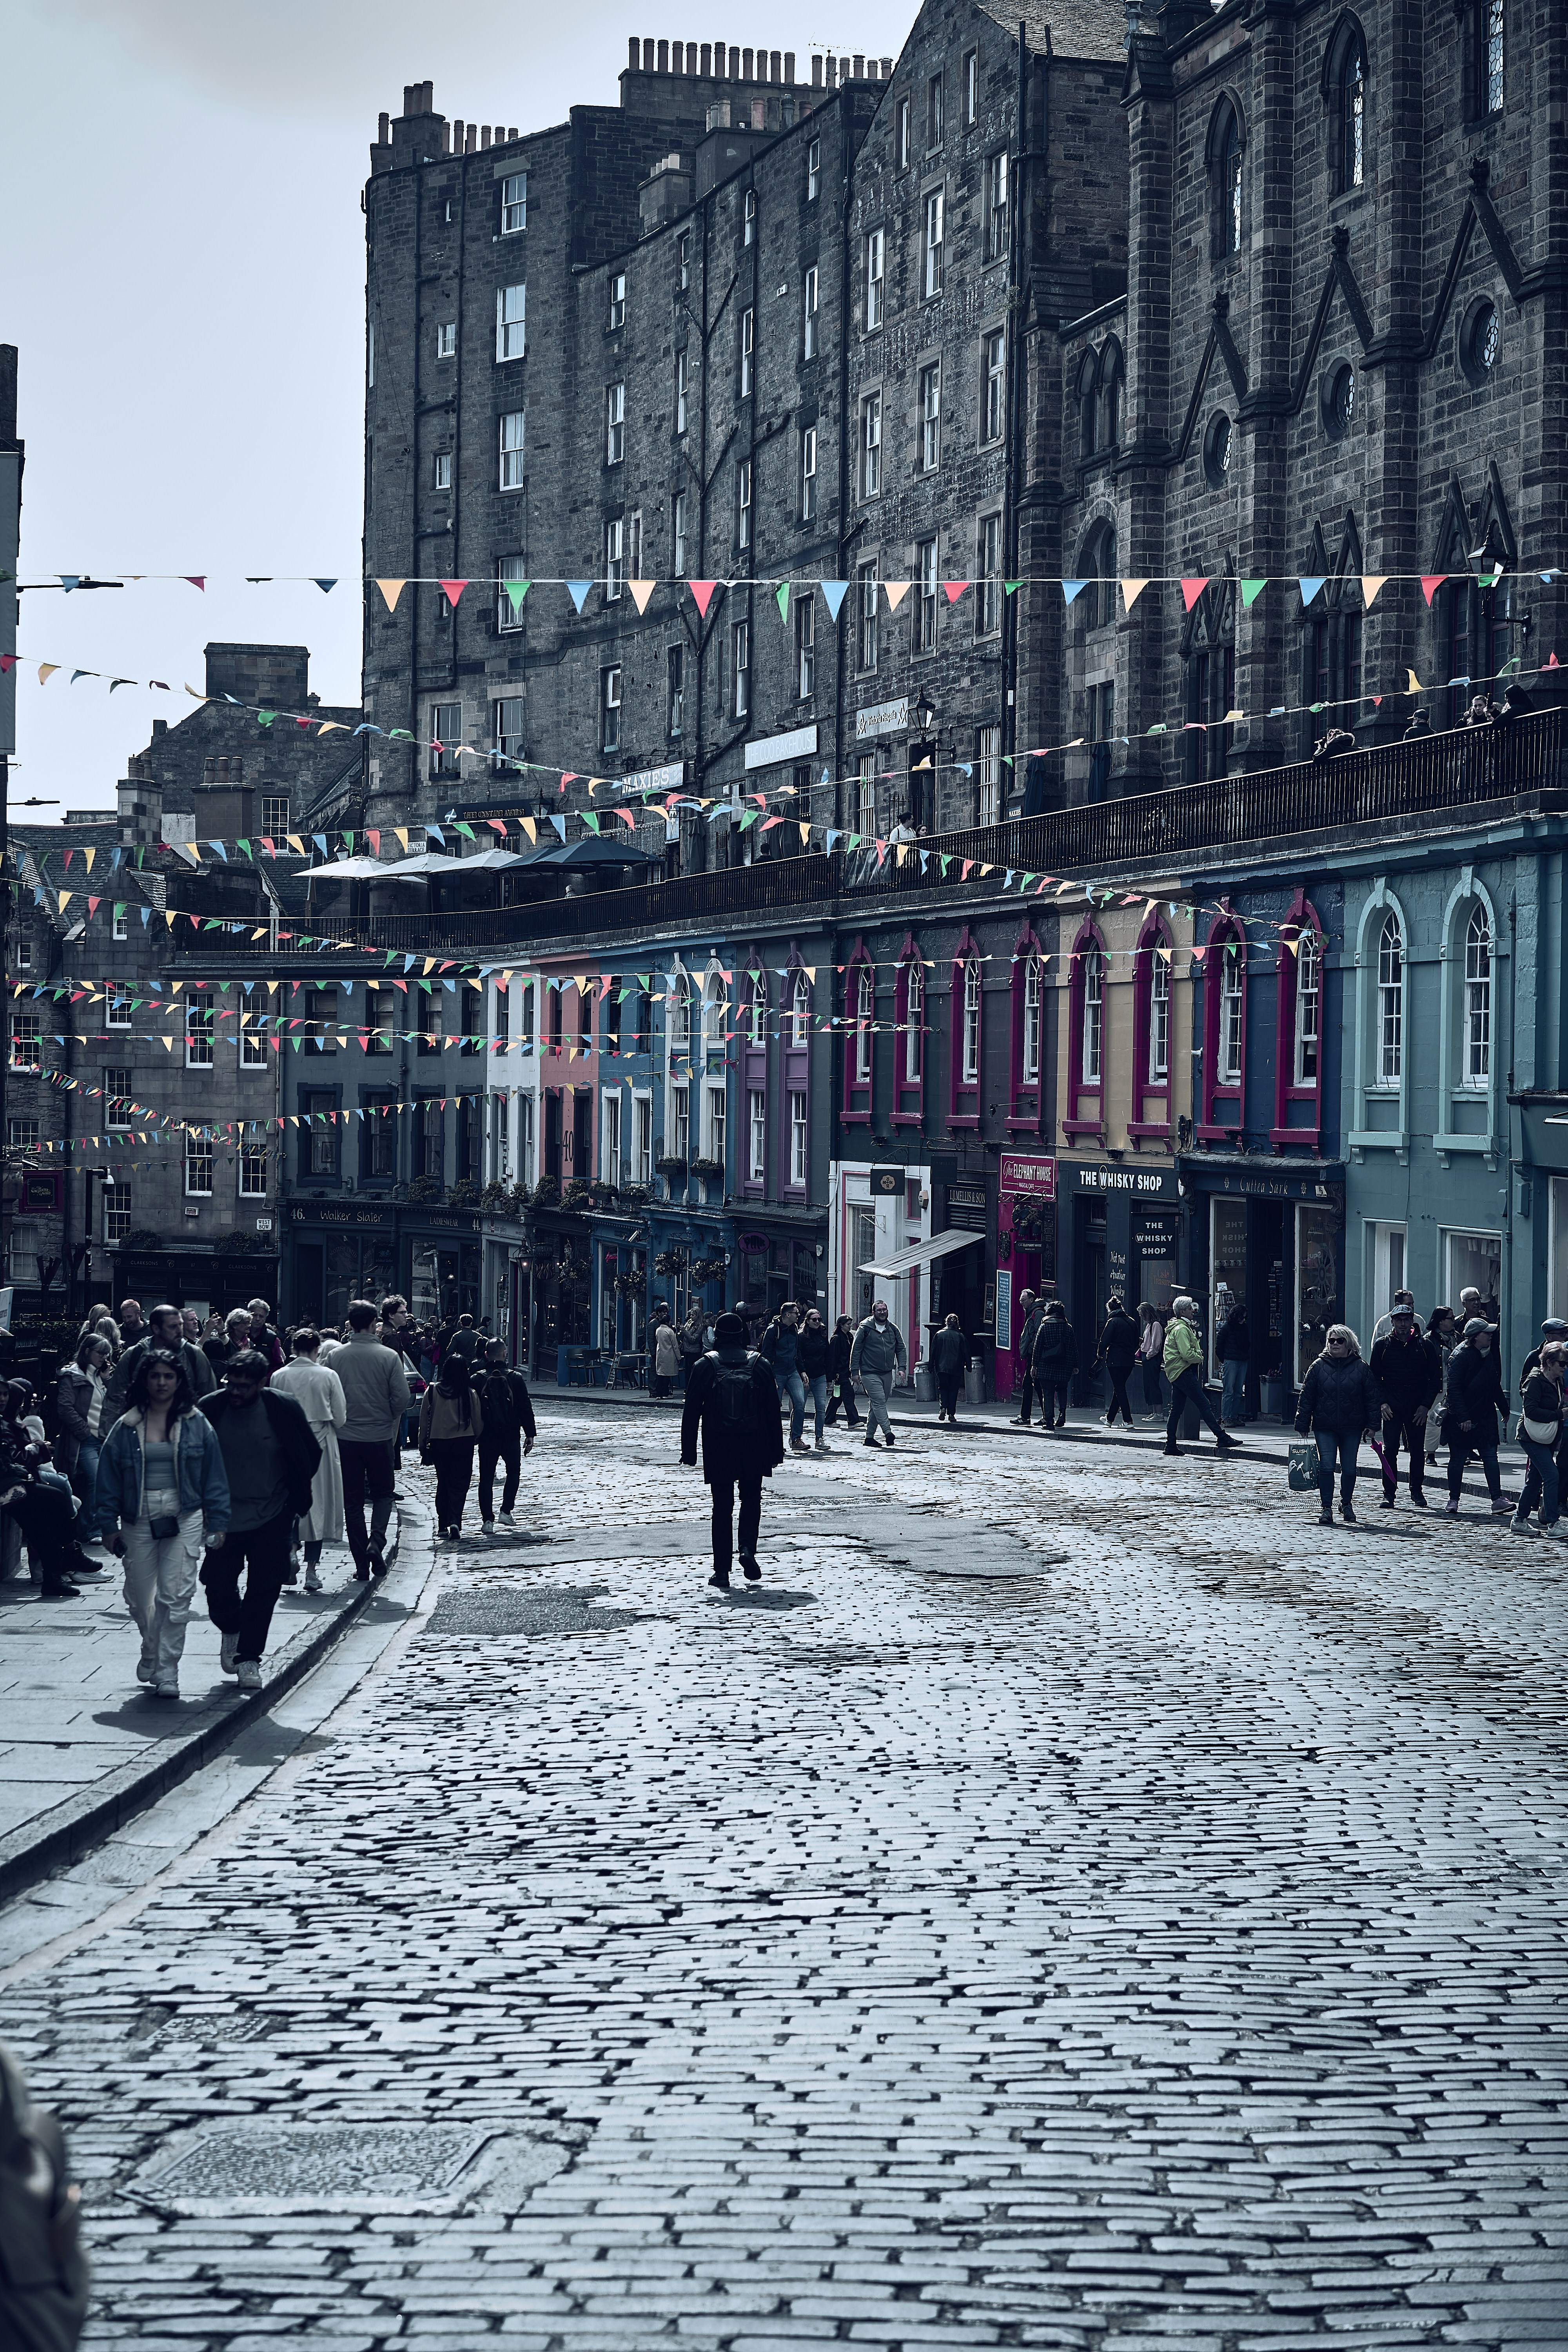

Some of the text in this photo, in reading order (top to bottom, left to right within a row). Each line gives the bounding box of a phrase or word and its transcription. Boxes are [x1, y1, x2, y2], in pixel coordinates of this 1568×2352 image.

[868, 710, 897, 726] Victoria Regalia
[746, 730, 815, 765] THE COO BAKEHOUSE
[622, 767, 669, 794] MAXIES
[504, 808, 525, 817] ARMS
[1009, 808, 1021, 817] MAXIES
[563, 1130, 573, 1162] 40
[1003, 1160, 1051, 1182] The ELEPHANT HOUSE
[1080, 1171, 1162, 1191] THE WHISKY SHOP
[1240, 1176, 1288, 1194] Cuttea Sark
[972, 1192, 975, 1202] &
[976, 1192, 985, 1203] SON
[290, 1208, 305, 1220] 46.
[320, 1209, 383, 1222] Walker Slater
[430, 1216, 458, 1227] LADIESWEAR
[1117, 1254, 1125, 1268] Just
[1110, 1269, 1126, 1281] Another
[1157, 1269, 1167, 1279] Cask
[1110, 1283, 1125, 1302] Whisky
